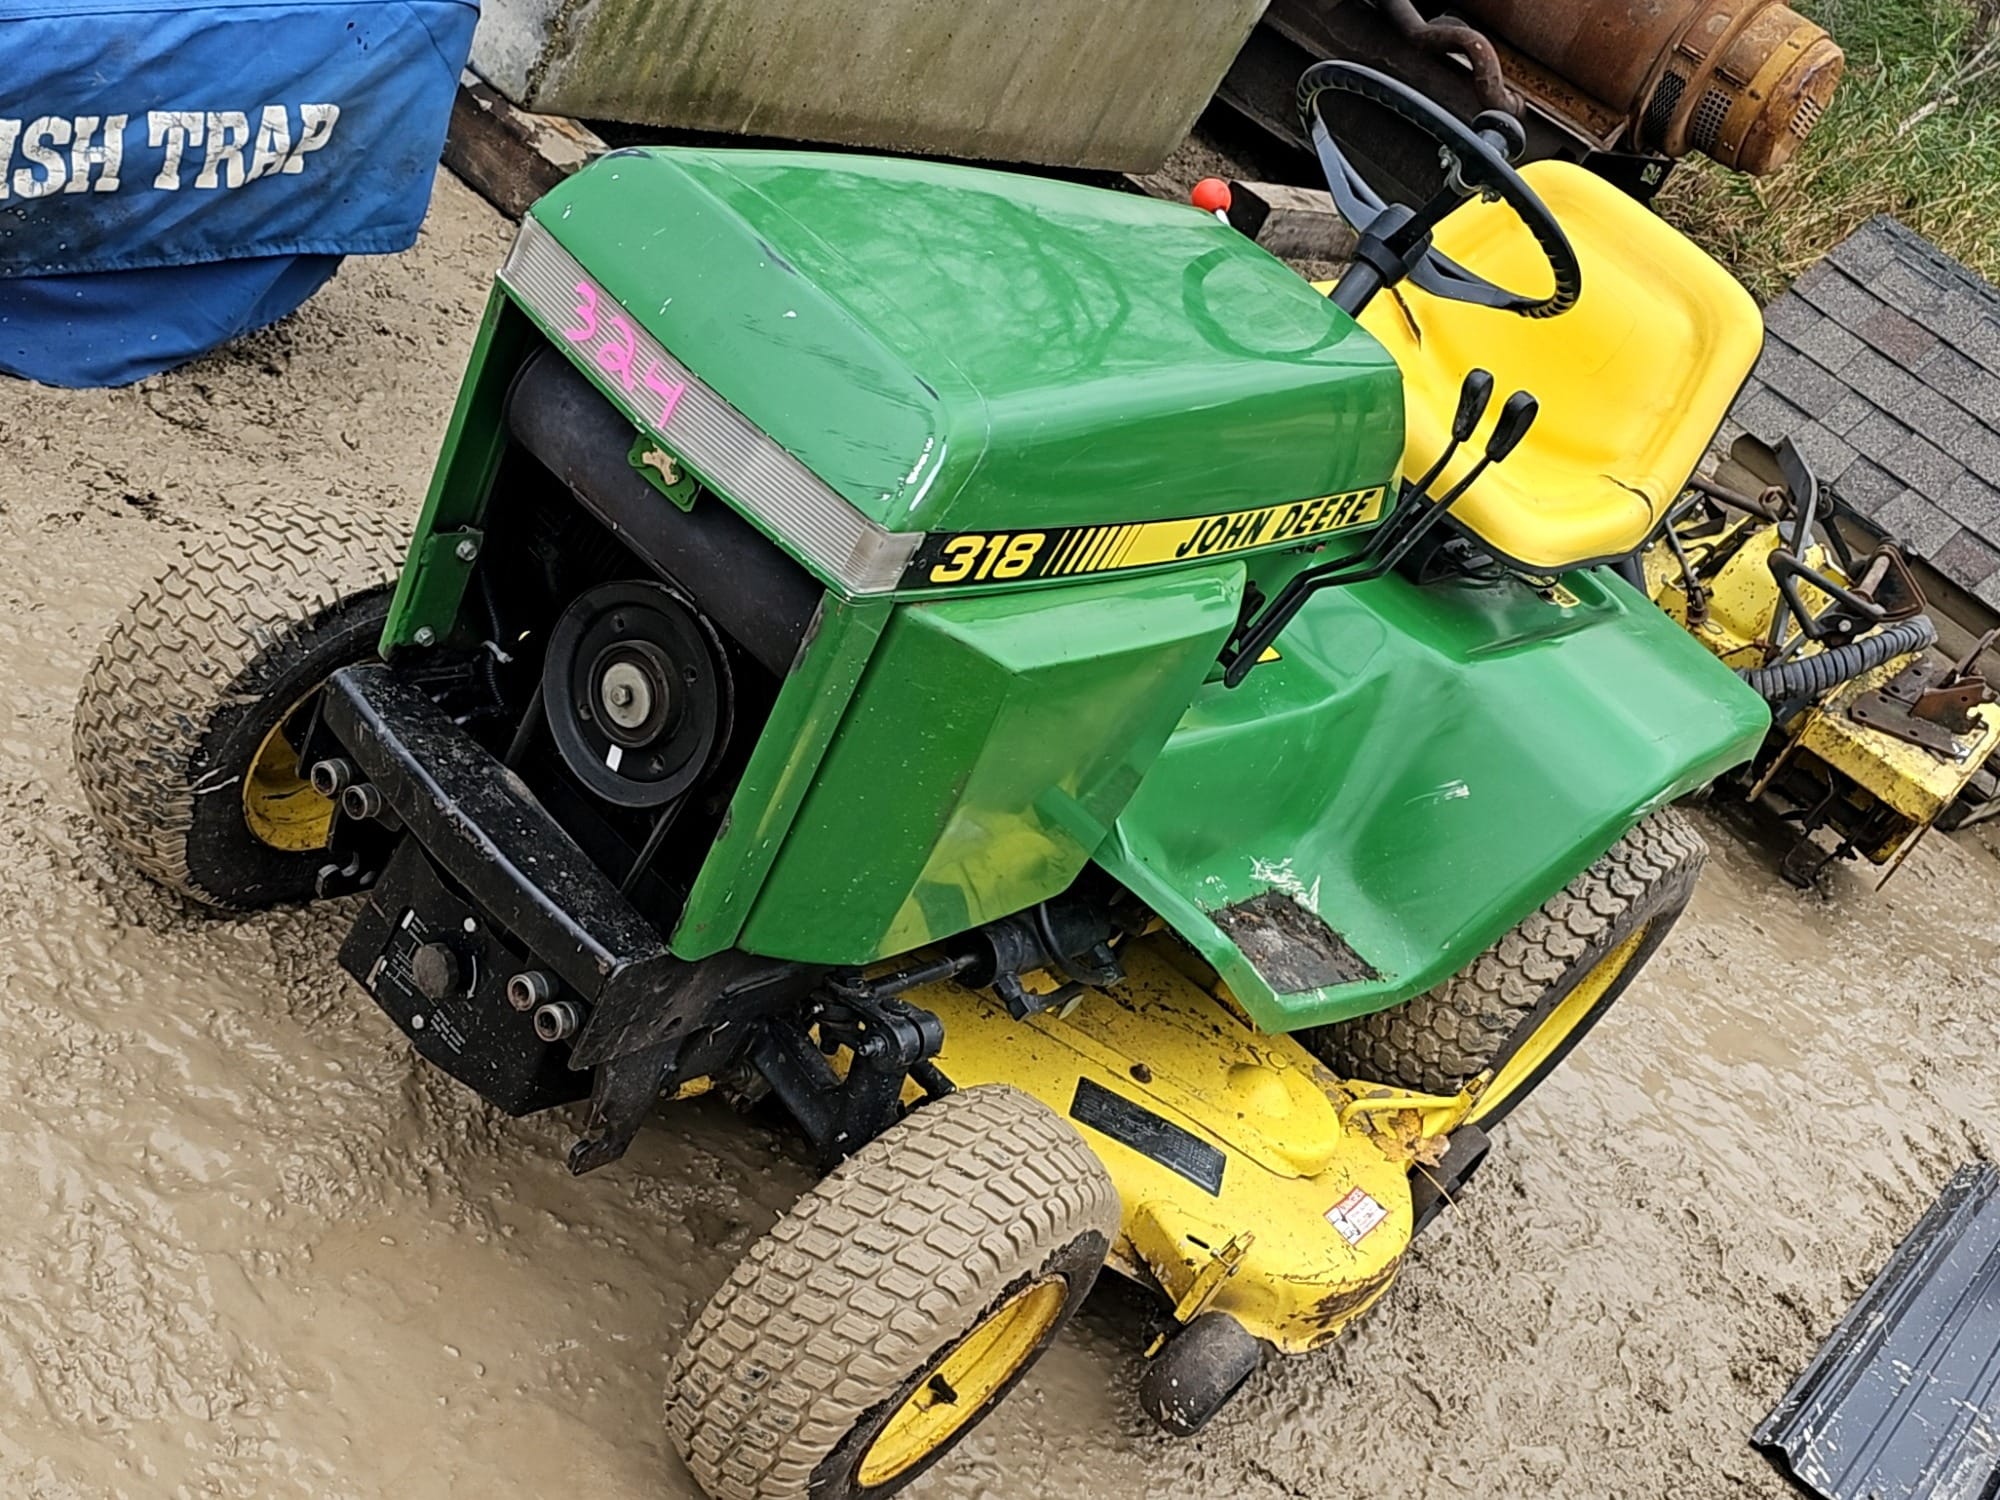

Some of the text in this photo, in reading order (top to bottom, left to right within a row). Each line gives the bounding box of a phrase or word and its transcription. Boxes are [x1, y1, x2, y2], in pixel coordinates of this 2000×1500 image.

[148, 104, 340, 190] TRAP
[565, 281, 687, 429] 324
[930, 490, 1377, 582] 318 JOHN DEERE
